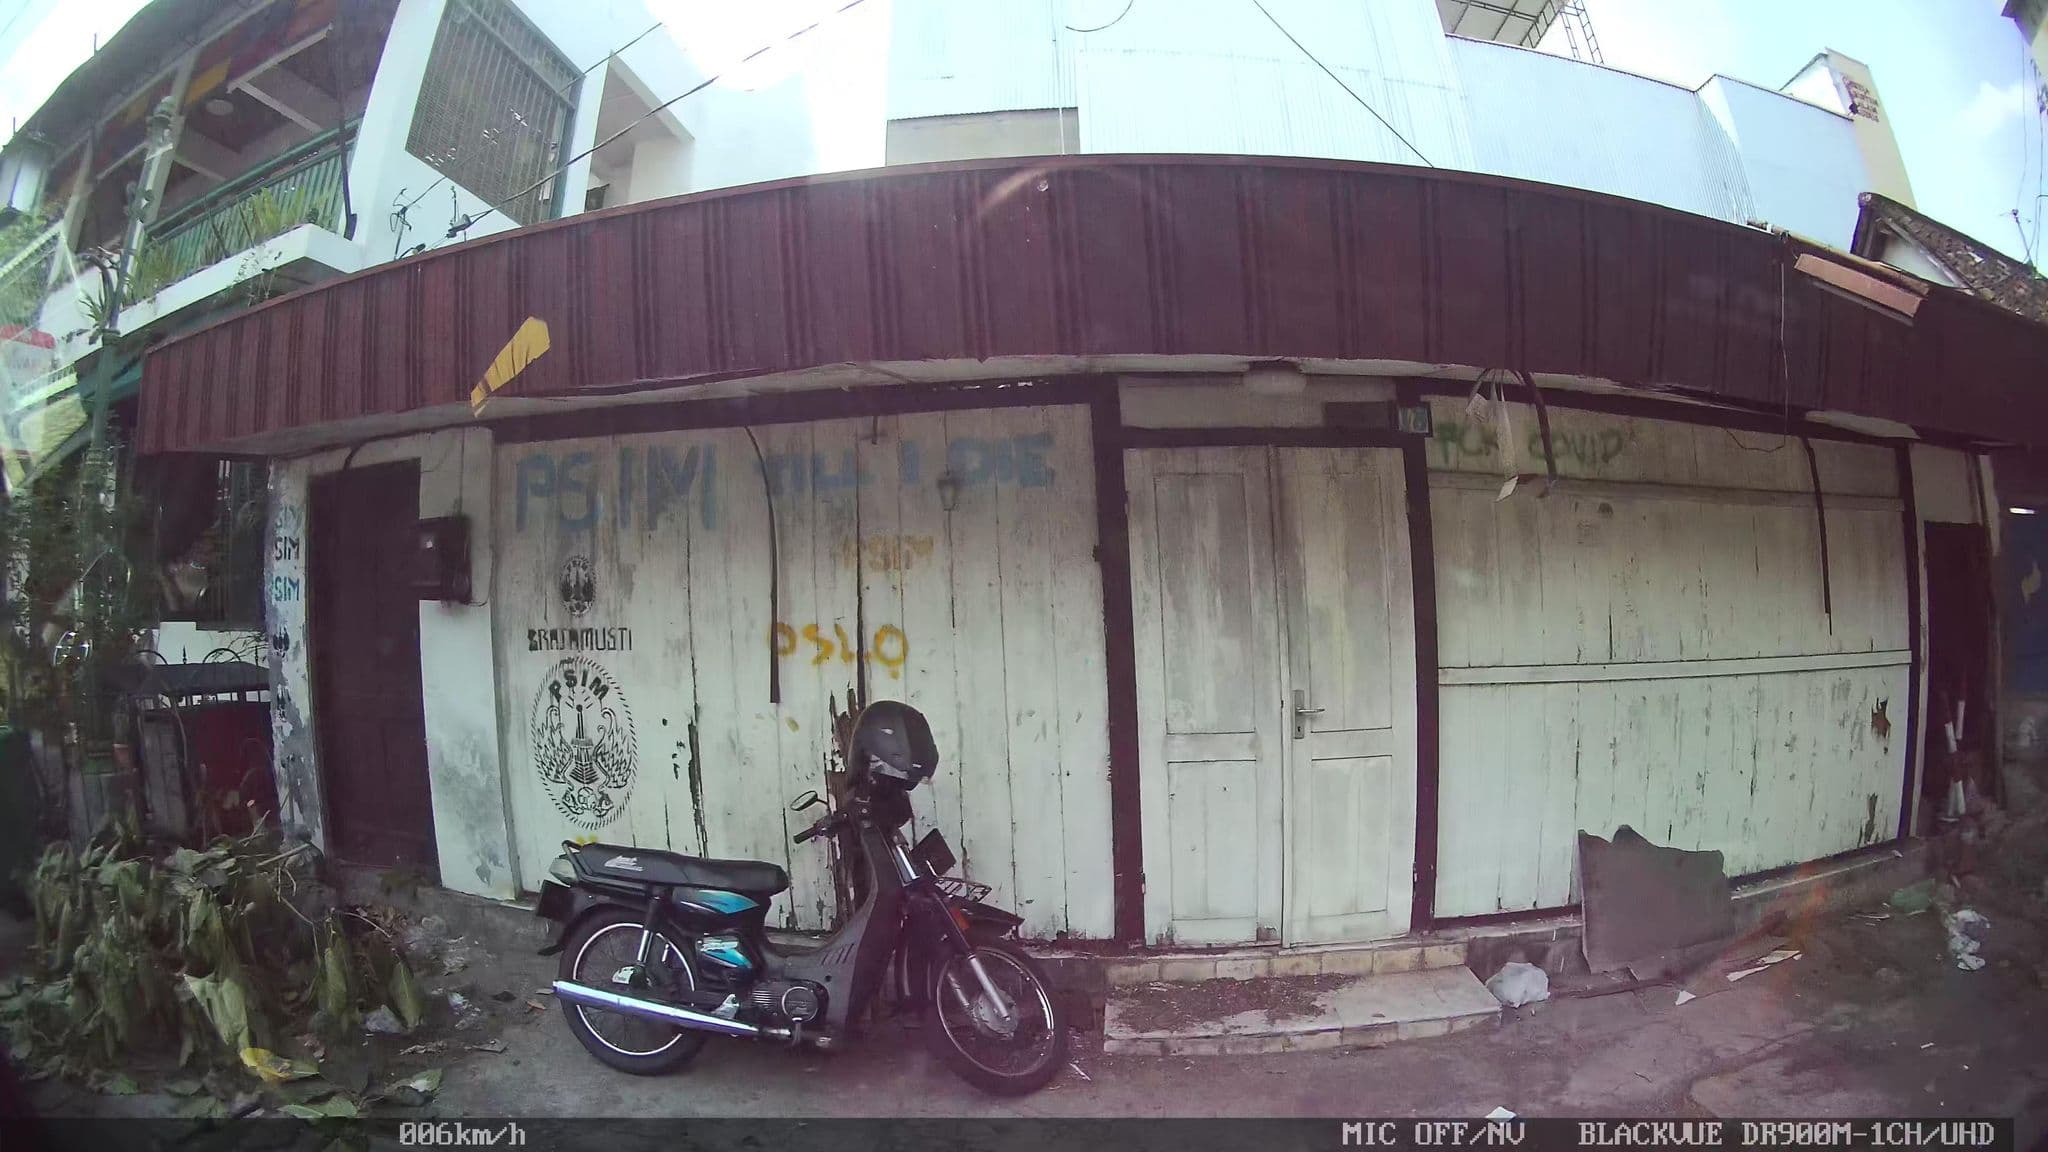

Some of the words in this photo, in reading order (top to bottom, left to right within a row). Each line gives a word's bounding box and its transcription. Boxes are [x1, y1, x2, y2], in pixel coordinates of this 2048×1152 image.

[515, 443, 717, 533] PSIM
[902, 440, 919, 484] I
[948, 431, 1056, 488] DIE
[548, 669, 610, 701] PSIM
